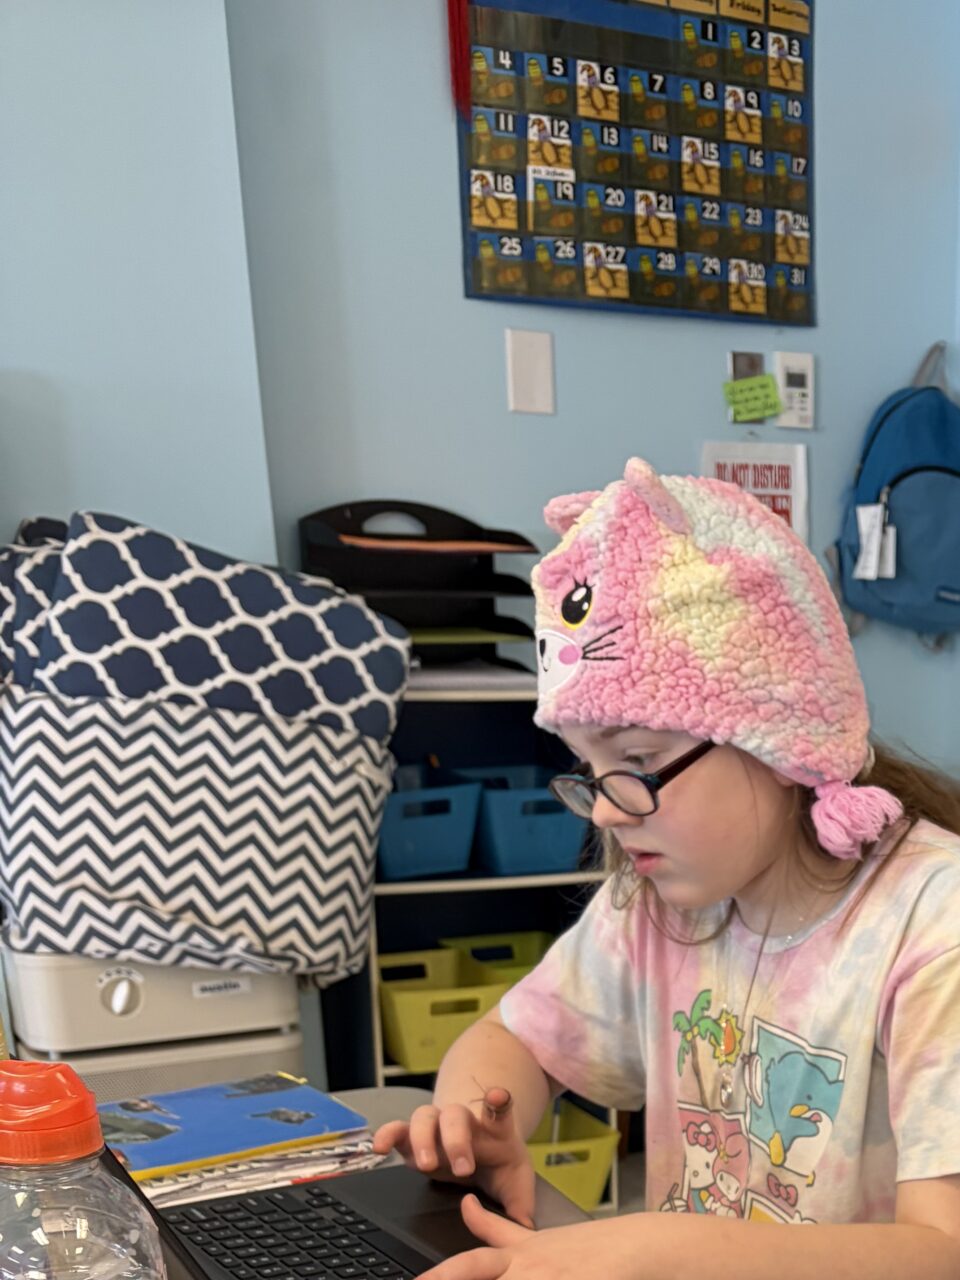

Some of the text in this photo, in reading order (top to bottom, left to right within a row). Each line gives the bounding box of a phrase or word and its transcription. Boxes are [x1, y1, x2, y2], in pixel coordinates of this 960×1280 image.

[706, 23, 800, 56] 1 2 3
[500, 51, 801, 118] 4 5 6 7 8 9 10
[499, 113, 806, 173] 11 12 13 14 15 16 17
[497, 175, 809, 230] 18 19 20 21 22 23 24
[500, 238, 806, 285] 25 26 27 28 29 30 31
[752, 464, 792, 489] DISTURB
